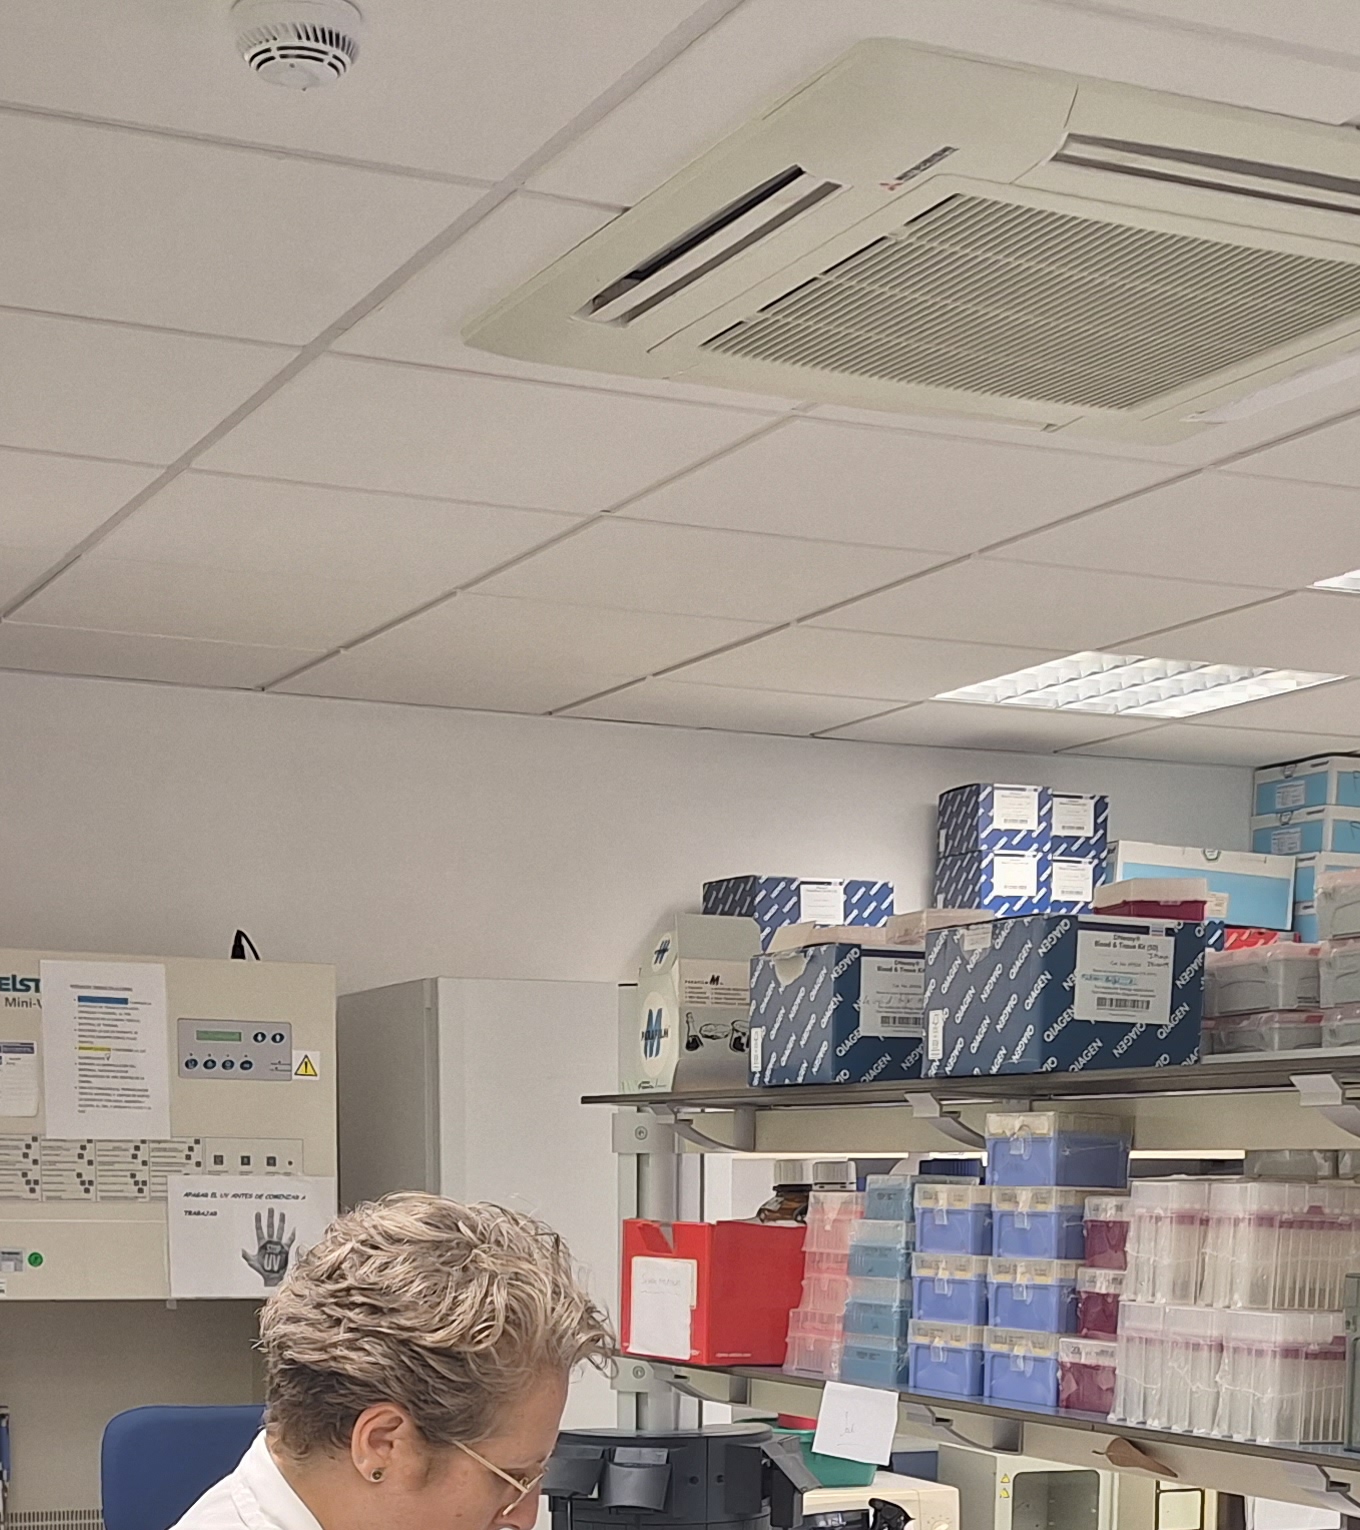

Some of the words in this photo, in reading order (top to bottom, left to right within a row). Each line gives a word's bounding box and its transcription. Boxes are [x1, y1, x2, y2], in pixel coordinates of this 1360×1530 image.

[1038, 919, 1071, 958] QIAGEN
[831, 948, 860, 980] QIAGEN
[941, 956, 962, 994] QIAGEN
[1009, 939, 1033, 980] QIAGEN
[981, 964, 1003, 1003] QIAGEN
[1024, 970, 1053, 1011] QIAGEN
[955, 986, 976, 1024] QIAGEN
[995, 993, 1018, 1033] QIAGEN
[1156, 1002, 1191, 1040] QIAGEN
[836, 1028, 861, 1057] QIAGE
[970, 1015, 991, 1054] QIAGEN
[264, 1253, 281, 1271] UV
